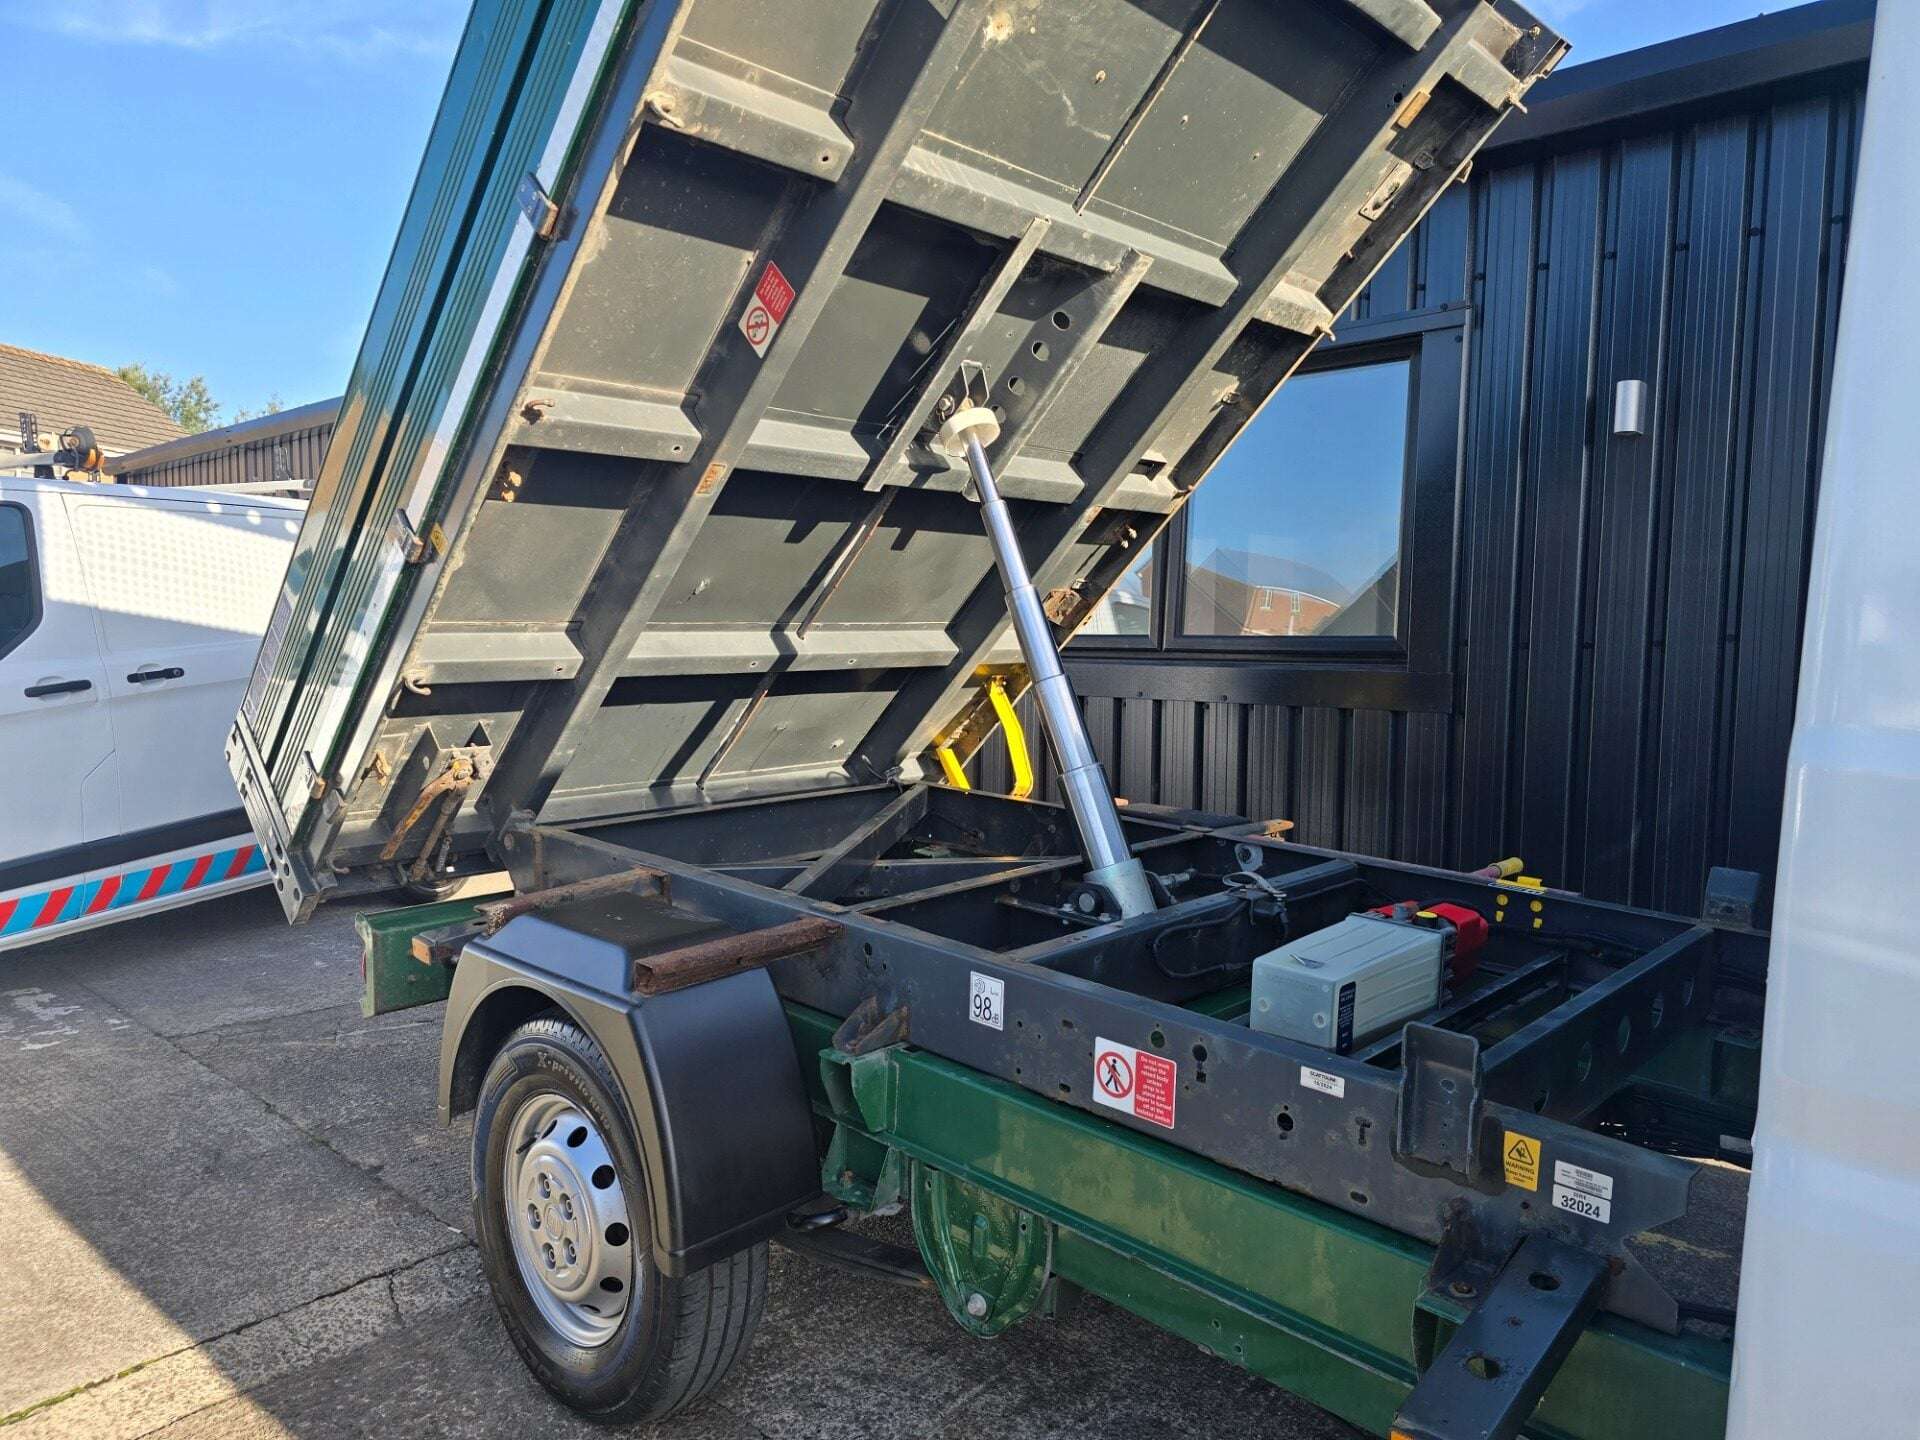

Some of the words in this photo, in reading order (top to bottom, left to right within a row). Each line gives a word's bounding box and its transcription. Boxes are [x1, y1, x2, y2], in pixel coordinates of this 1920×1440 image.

[973, 993, 992, 1021] 98
[1505, 1160, 1535, 1175] WARNING
[1560, 1194, 1601, 1219] 32024
